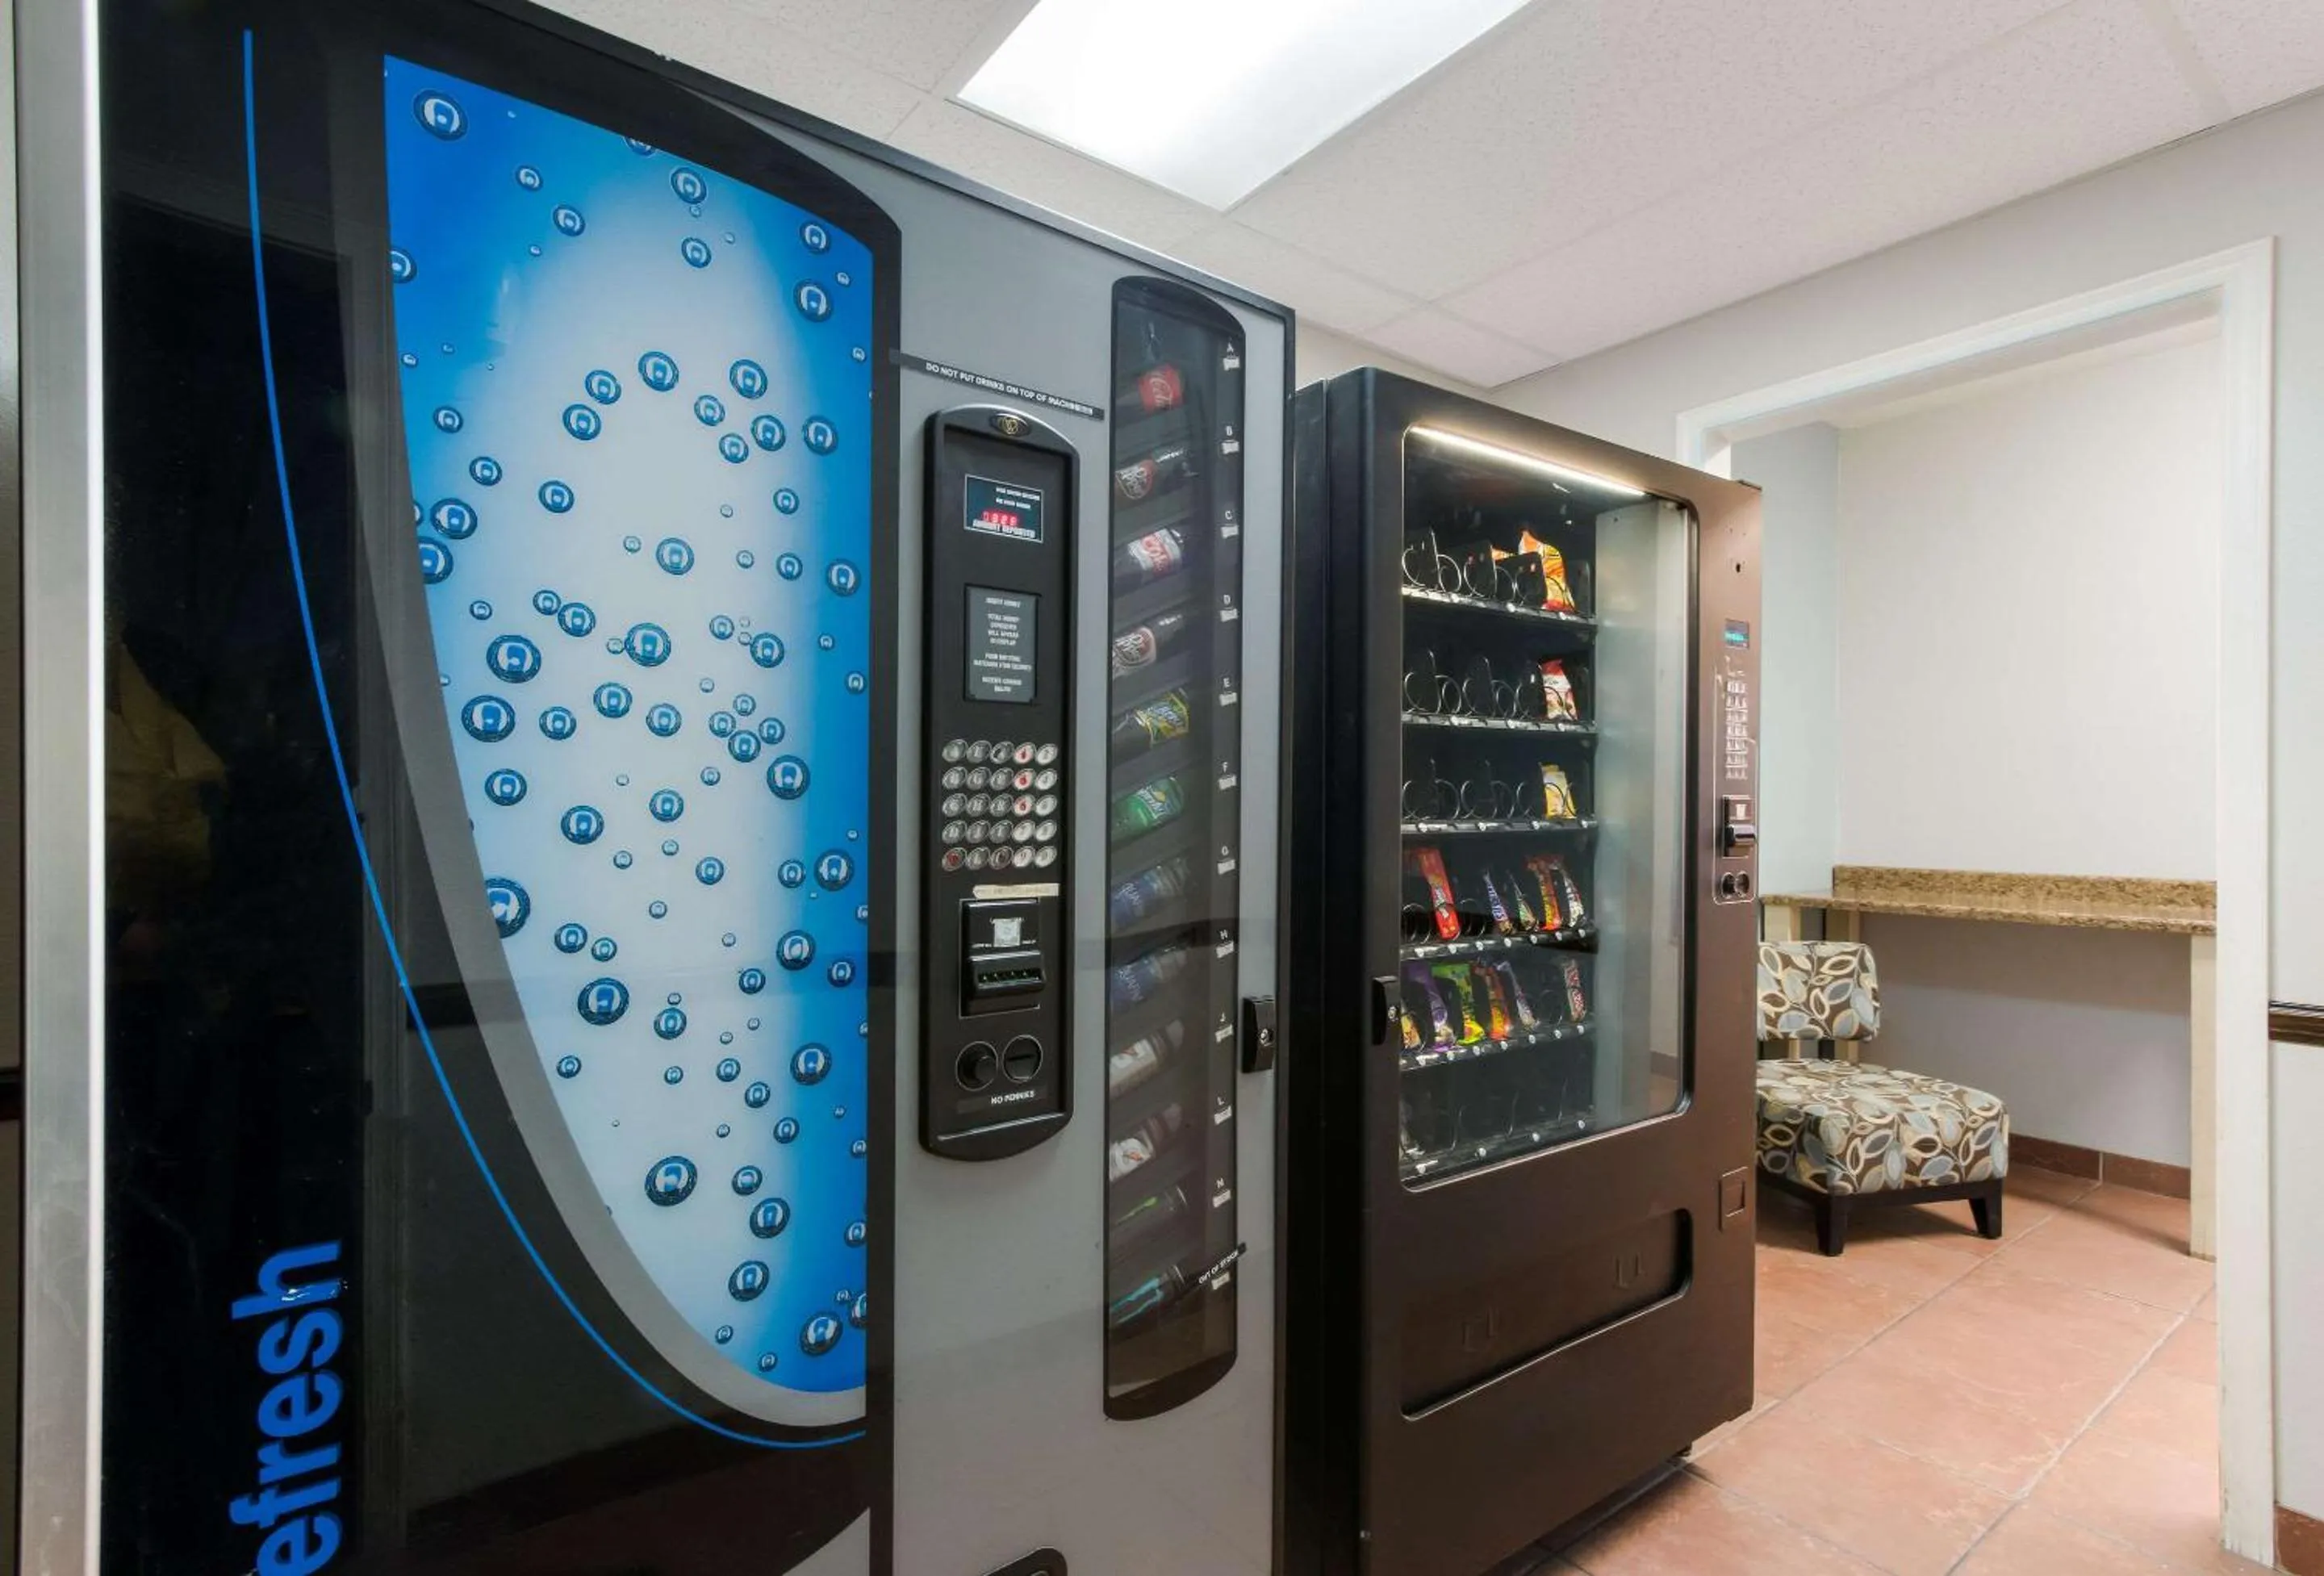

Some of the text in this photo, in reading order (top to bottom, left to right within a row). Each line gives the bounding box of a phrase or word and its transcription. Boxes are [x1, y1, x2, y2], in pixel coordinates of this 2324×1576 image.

[926, 362, 939, 373] DO
[940, 366, 958, 378] NOT
[959, 372, 975, 383] PUT
[1006, 385, 1018, 395] ON
[1019, 387, 1035, 399] TOP
[1036, 393, 1047, 402] OF
[1224, 509, 1233, 520] C
[1223, 594, 1231, 605] D
[1223, 677, 1231, 688] E
[1215, 1177, 1225, 1189] N
[1198, 1270, 1211, 1285] OUT
